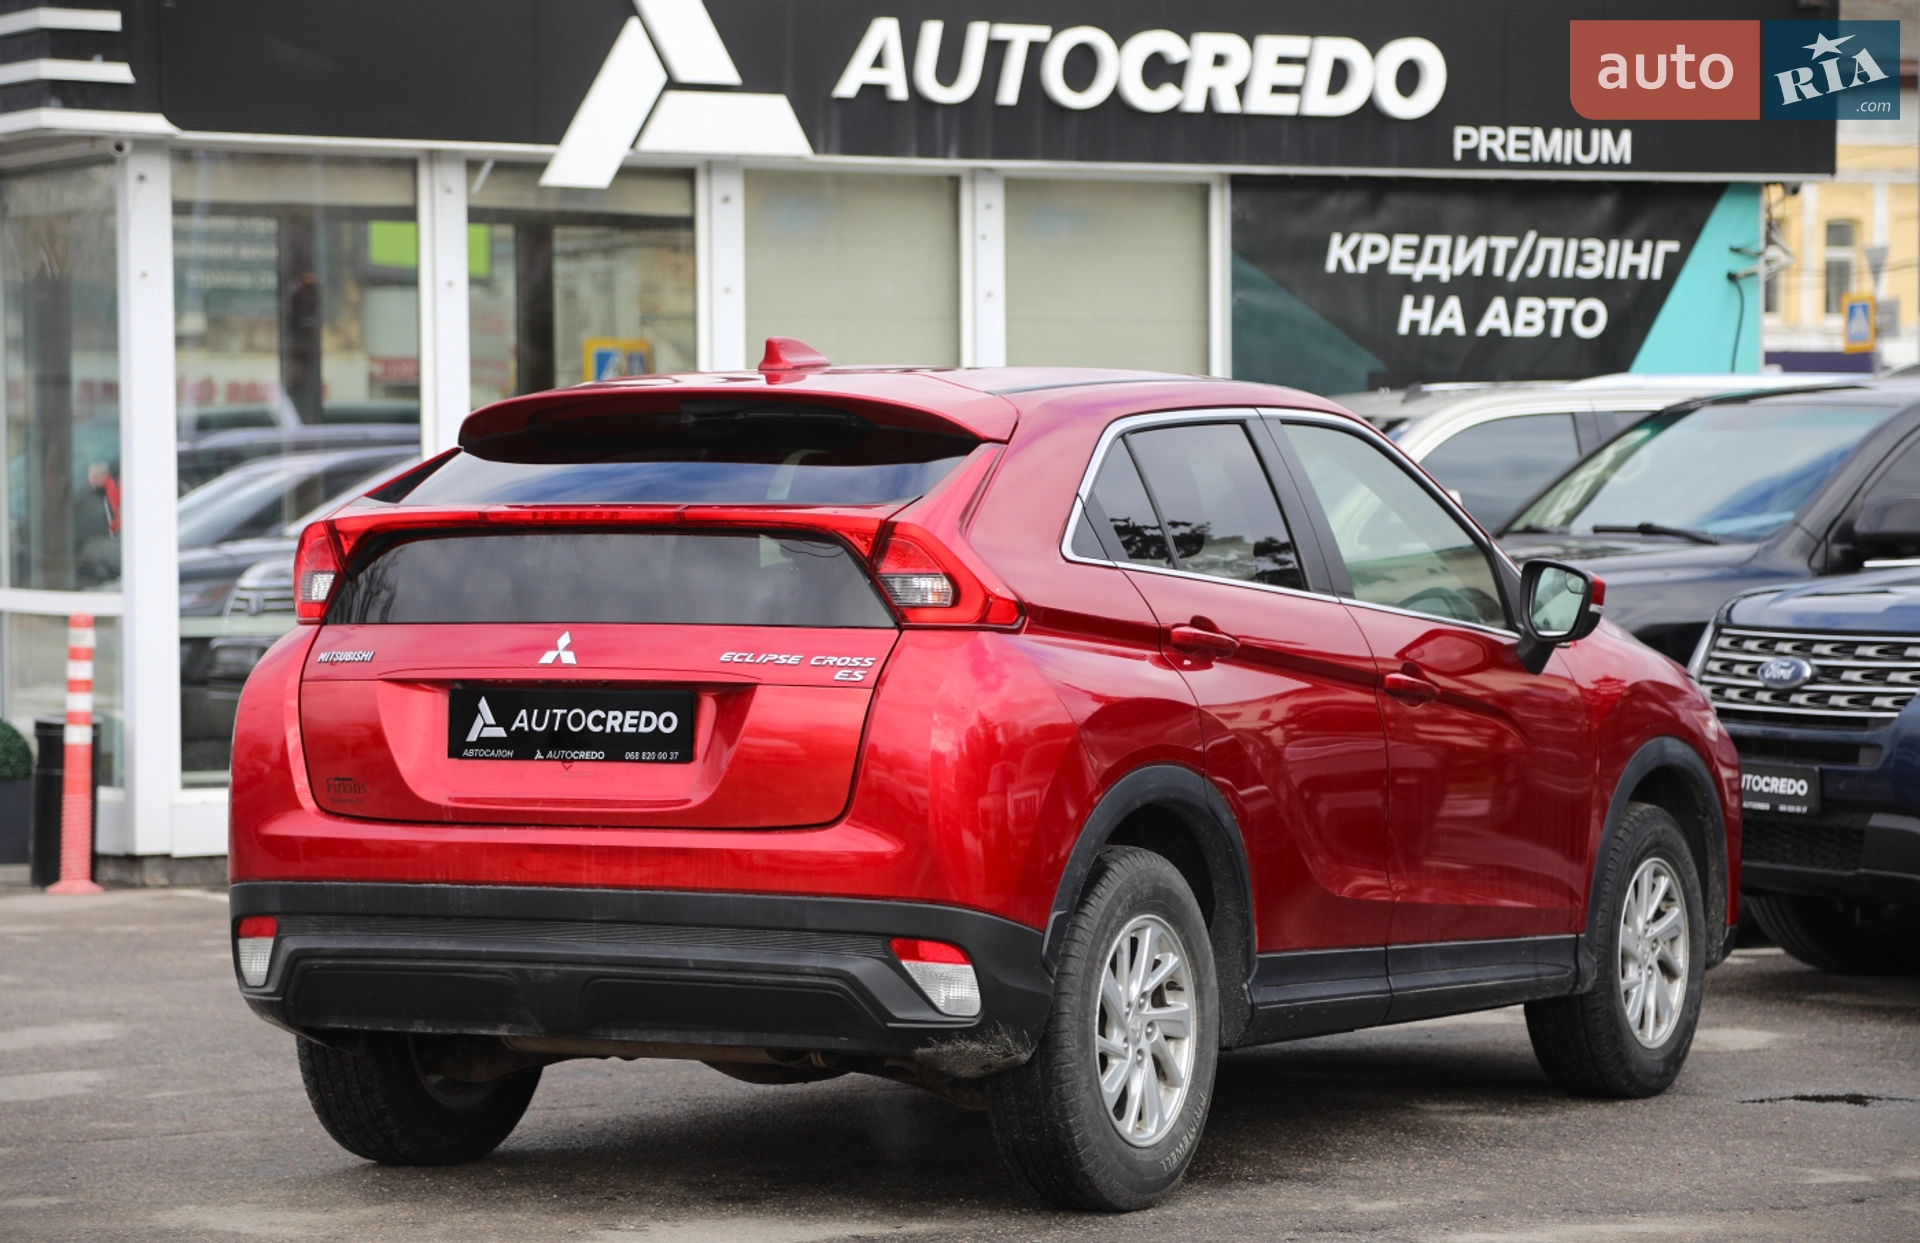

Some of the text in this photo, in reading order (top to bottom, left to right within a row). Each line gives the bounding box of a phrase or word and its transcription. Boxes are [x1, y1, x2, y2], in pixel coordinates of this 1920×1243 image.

[831, 16, 1447, 120] AUTOCREDO
[1453, 126, 1632, 165] PREMIUM
[1325, 230, 1681, 283] КРЕДИТ/ЛІЗІНГ
[1397, 294, 1608, 339] НА АВТО
[317, 651, 375, 663] MITSUBISHI
[719, 652, 877, 667] ECLIPSE CROSS
[834, 669, 868, 682] ES
[1764, 660, 1797, 680] Ford
[510, 708, 679, 734] AUTOCREDO
[462, 748, 514, 759] АВТОСАЛОН
[546, 750, 605, 760] AUTOCREDO
[669, 751, 679, 760] 37
